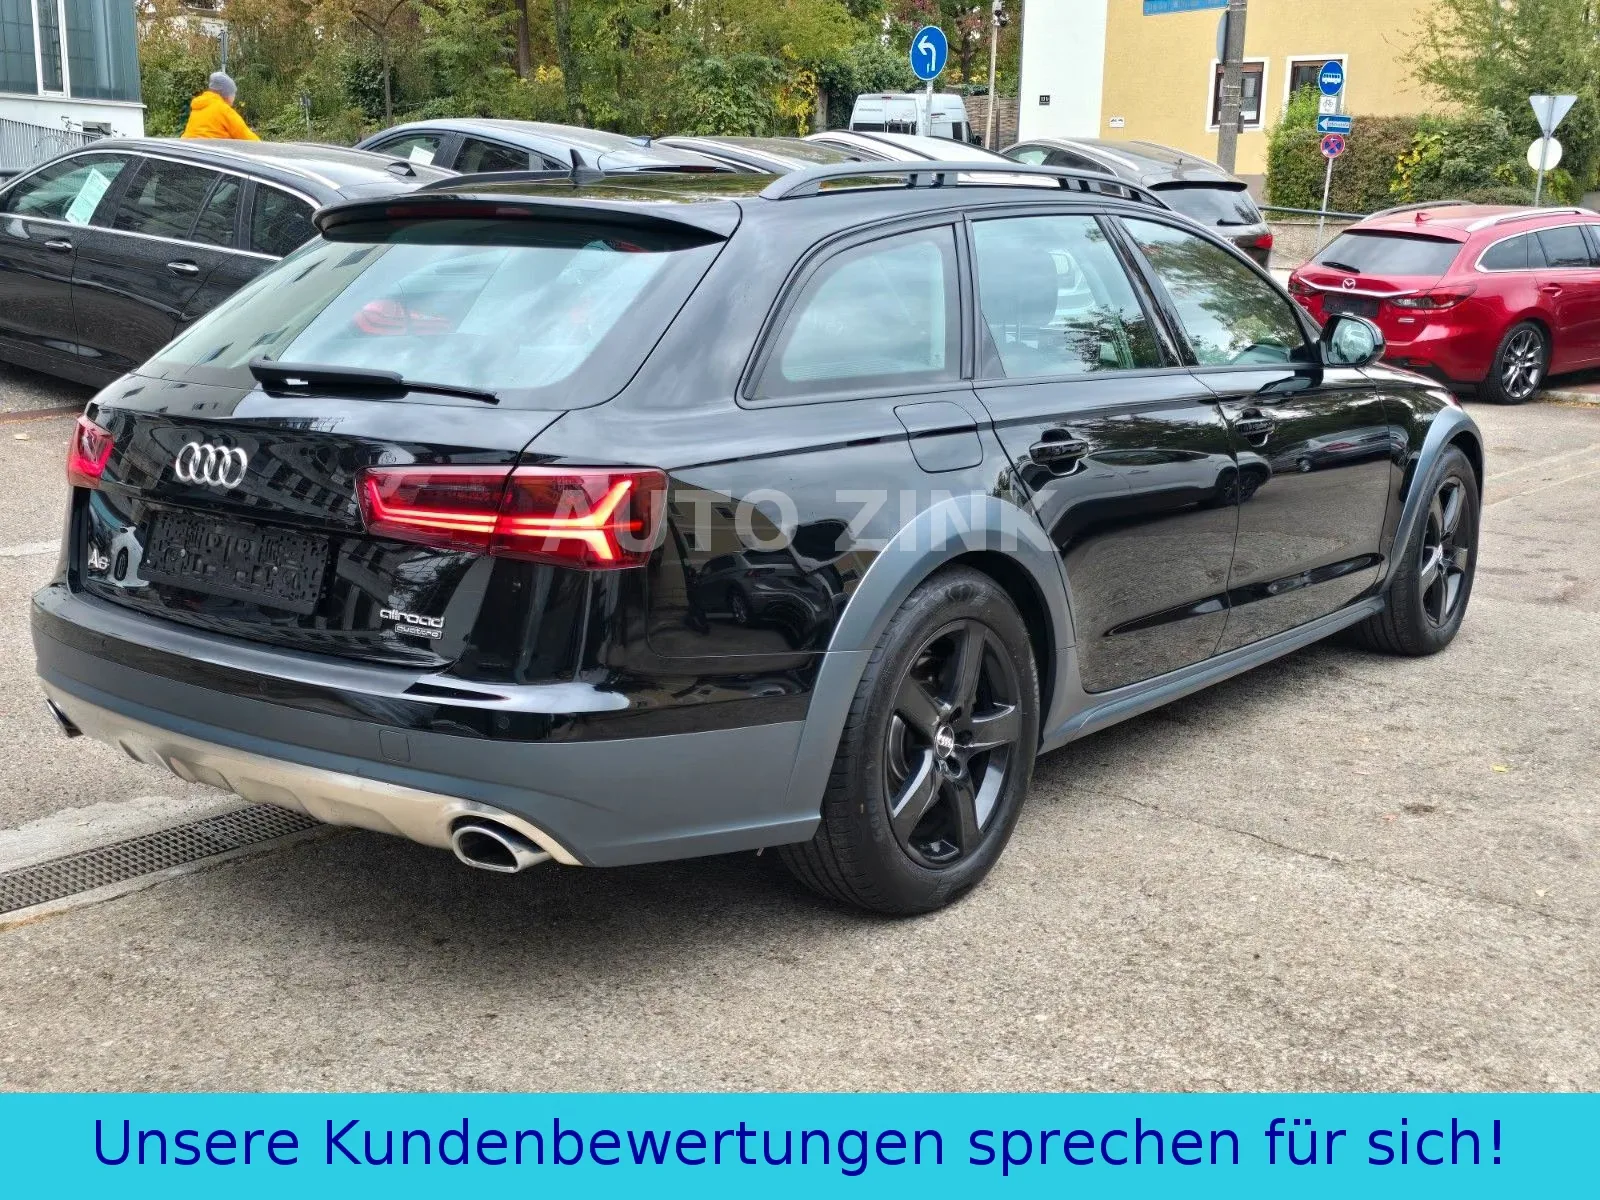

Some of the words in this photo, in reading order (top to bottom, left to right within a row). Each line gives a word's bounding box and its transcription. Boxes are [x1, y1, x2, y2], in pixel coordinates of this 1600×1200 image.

[88, 548, 109, 570] A6
[380, 609, 445, 628] allroad
[396, 625, 439, 638] quattro
